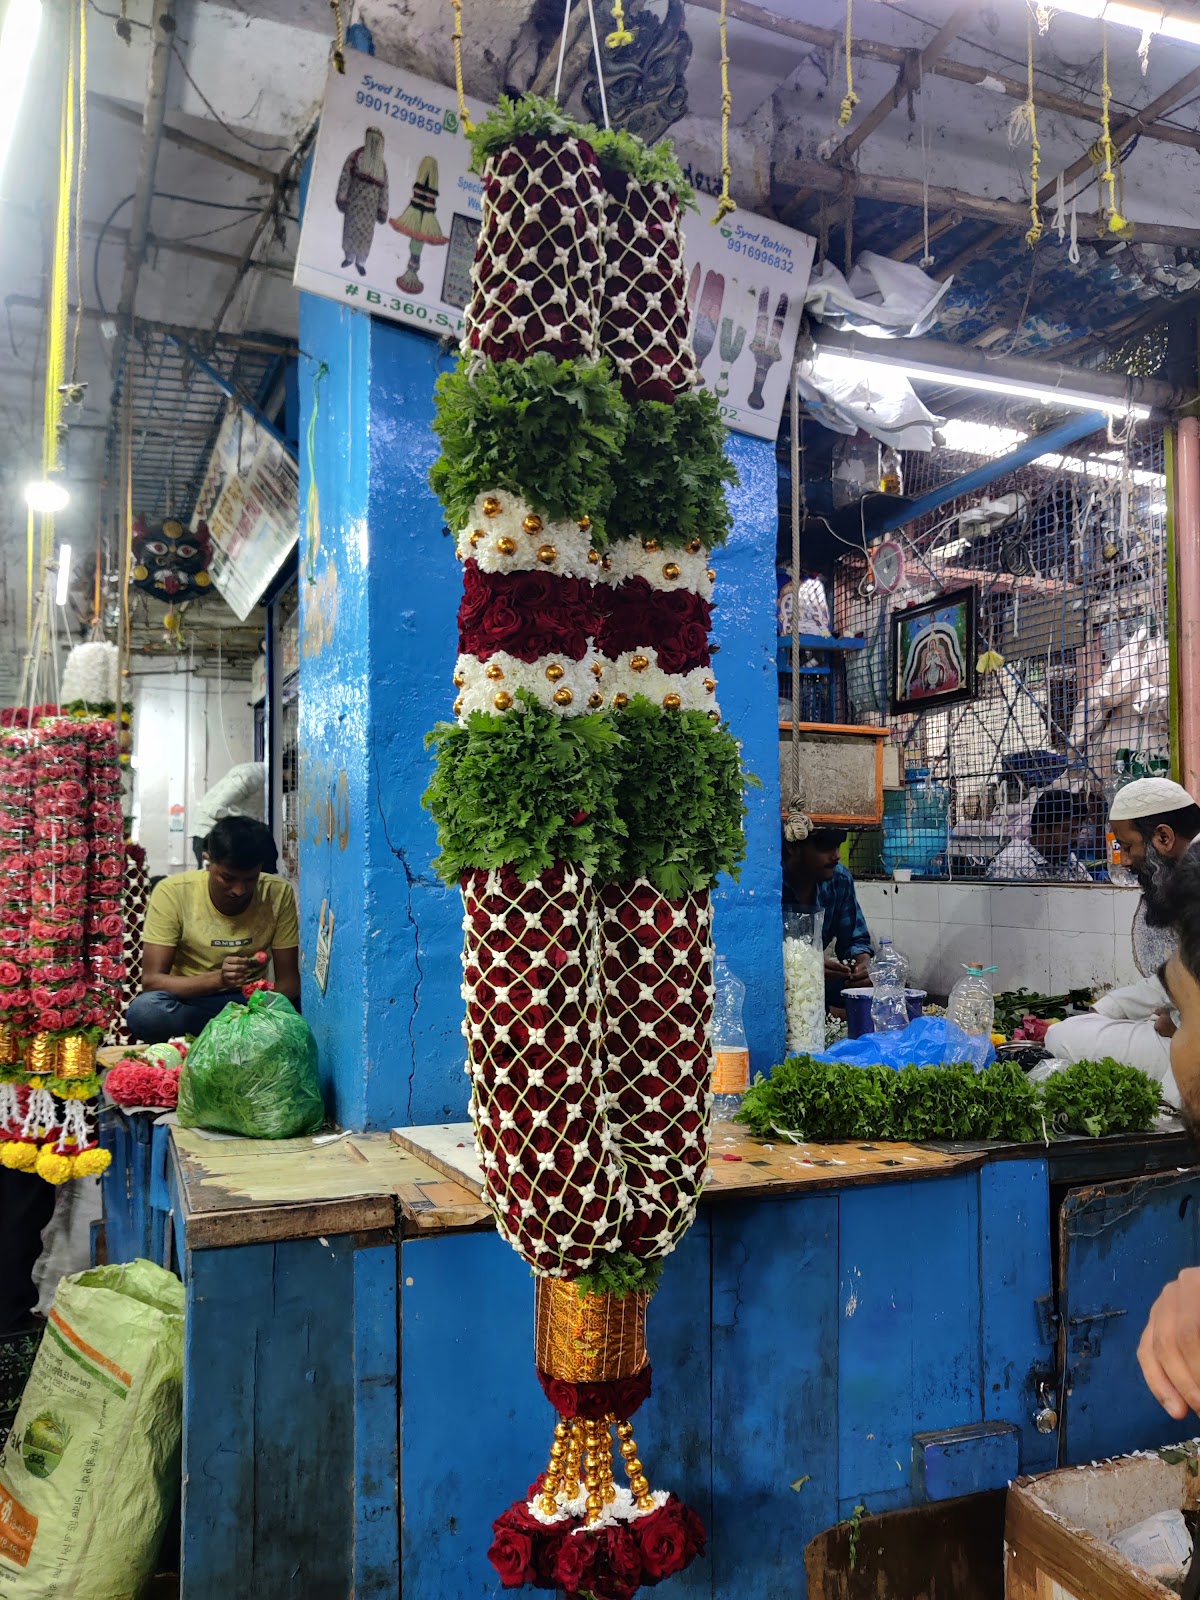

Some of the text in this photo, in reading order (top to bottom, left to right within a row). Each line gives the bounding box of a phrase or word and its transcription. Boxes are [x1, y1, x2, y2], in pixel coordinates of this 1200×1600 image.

[355, 90, 443, 135] 9901299859
[361, 74, 442, 116] Syed Imtiyaz
[457, 175, 484, 195] Specia
[727, 237, 795, 274] 9916996832
[734, 224, 793, 258] Syed Rahim
